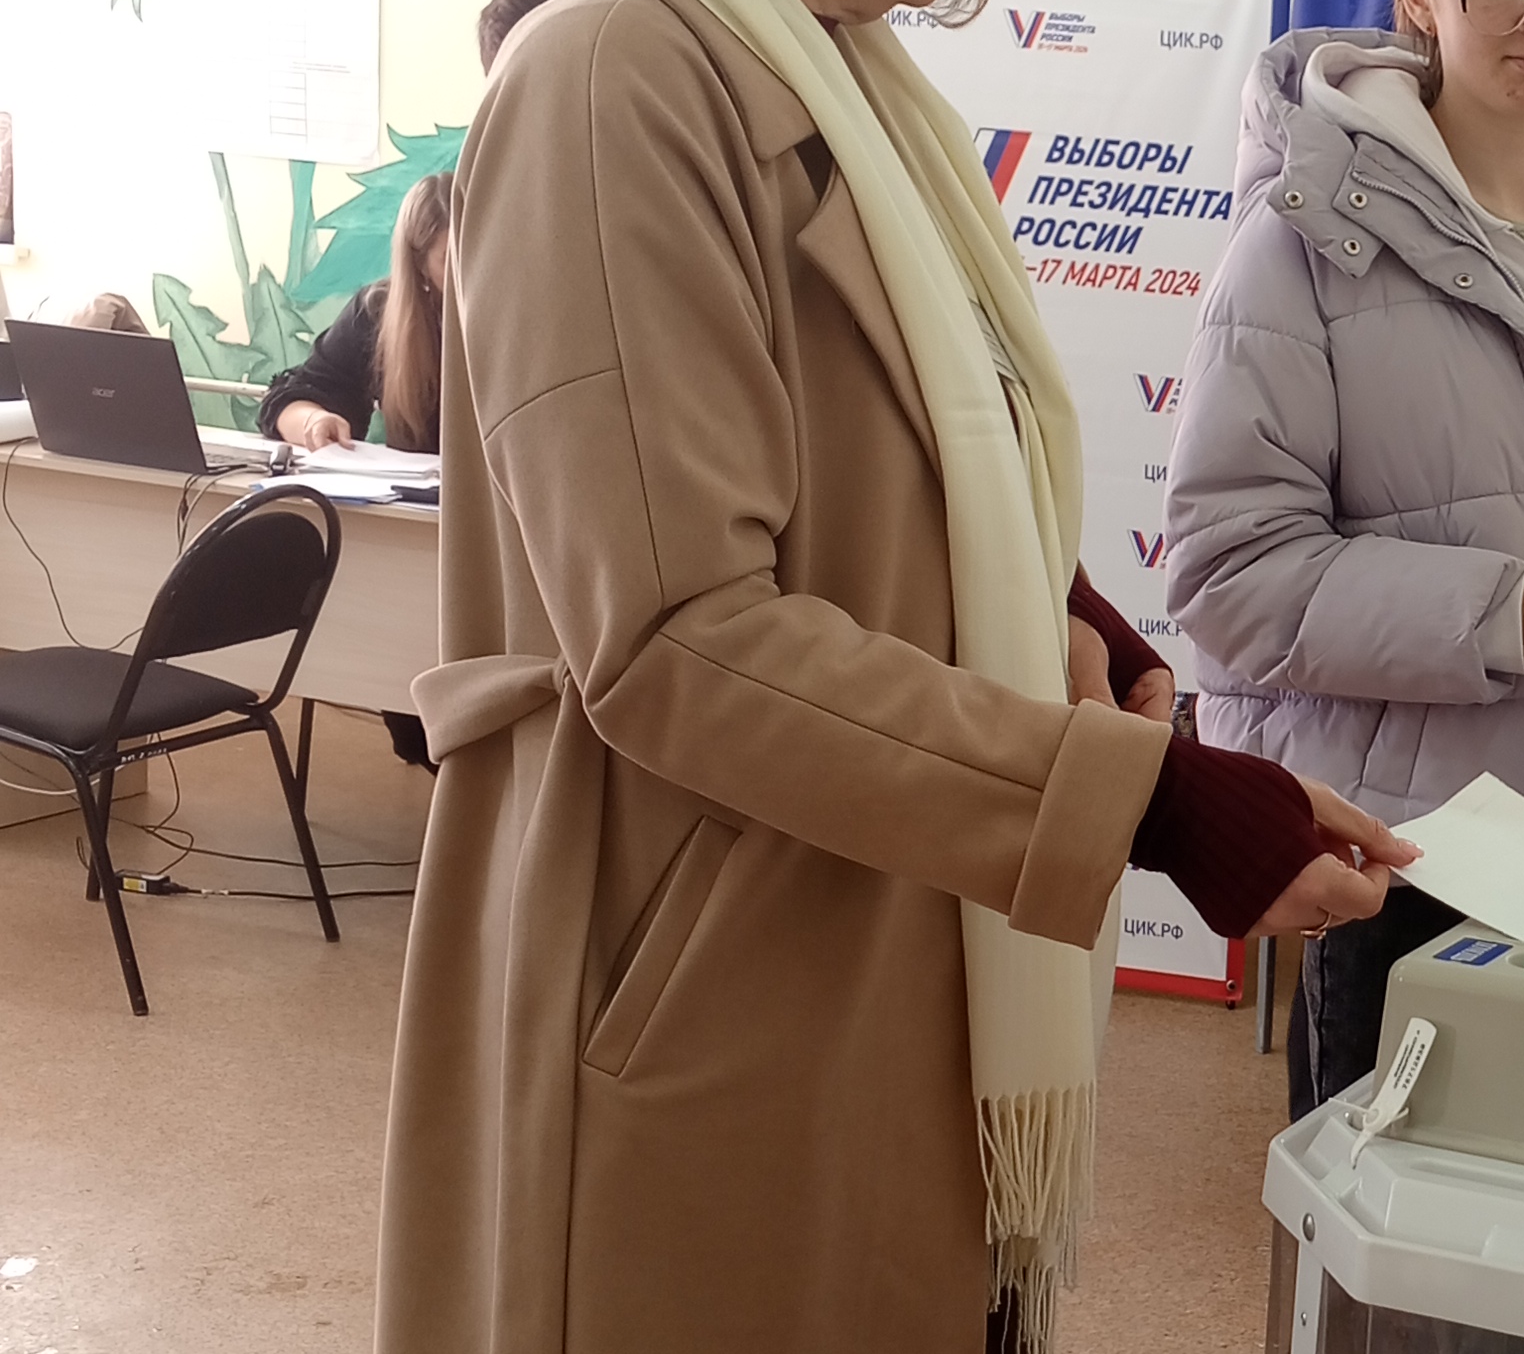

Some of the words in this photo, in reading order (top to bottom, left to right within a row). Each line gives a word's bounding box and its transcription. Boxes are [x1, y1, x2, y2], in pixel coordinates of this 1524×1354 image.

[886, 9, 939, 29] ИК.РФ
[1160, 29, 1224, 50] ЦИК.РФ
[1045, 134, 1194, 175] ВЫБОРЫ
[1027, 175, 1234, 221] ПРЕЗИДЕНТА
[1013, 216, 1144, 255] РОССИИ
[1062, 260, 1142, 292] МАРТА
[1143, 268, 1202, 297] 2024
[1138, 617, 1184, 637] ЦИК.Р
[1124, 918, 1184, 940] ЦИК.РФ
